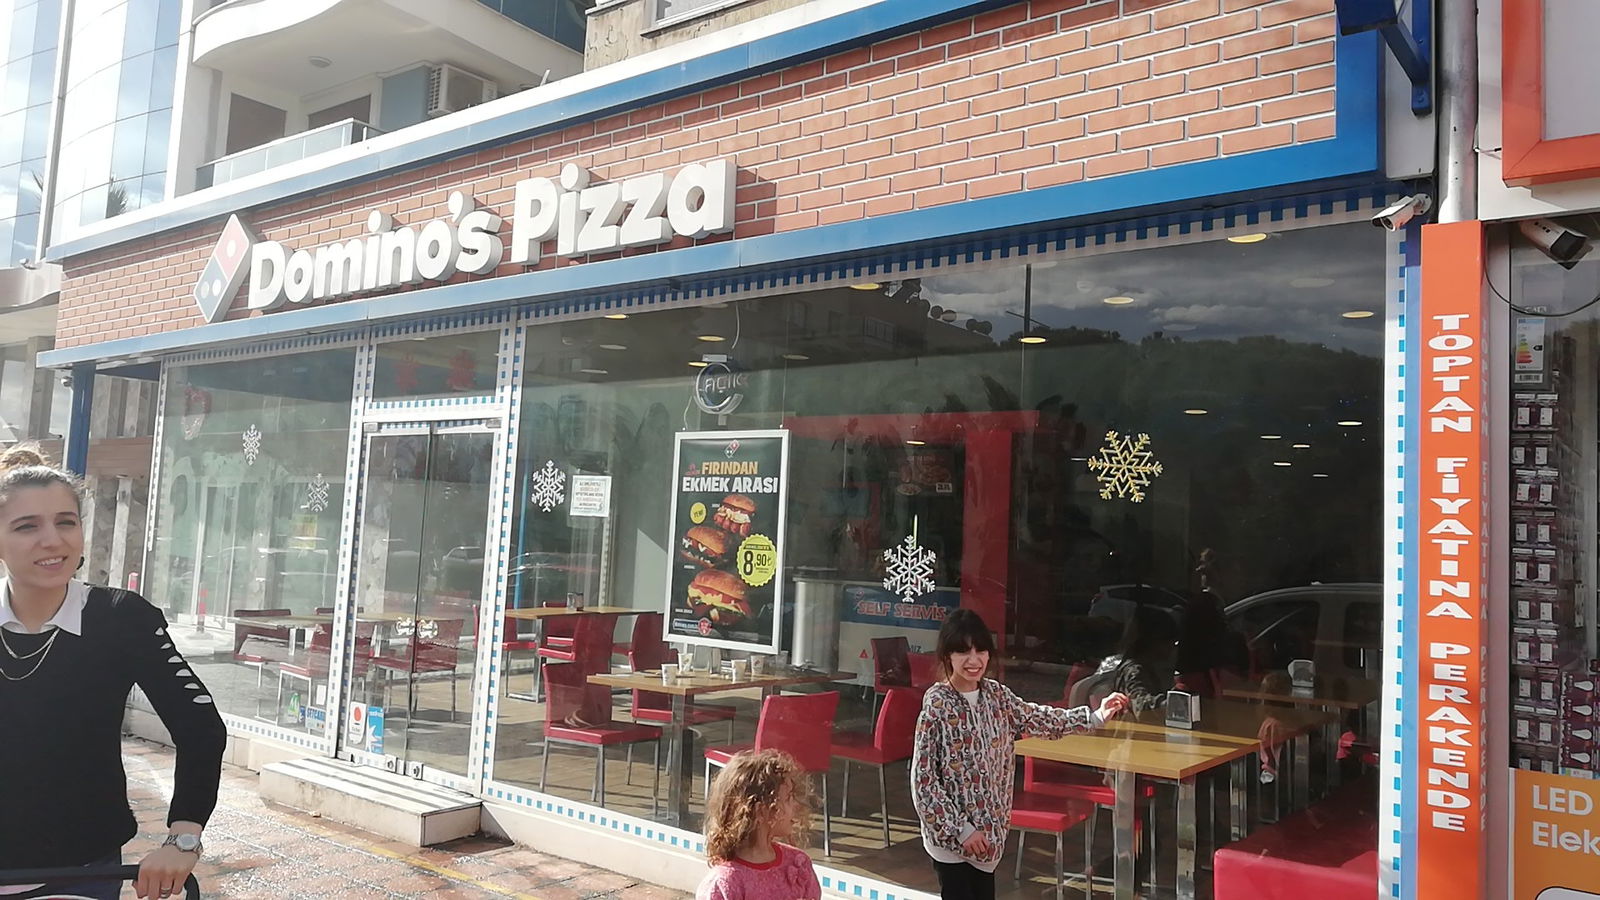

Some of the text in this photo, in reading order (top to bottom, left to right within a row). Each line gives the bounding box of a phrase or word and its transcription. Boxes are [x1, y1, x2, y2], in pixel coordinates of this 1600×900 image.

[247, 158, 737, 310] Domino's Pizza
[1428, 314, 1474, 432] TOPTAN
[701, 461, 758, 475] FIRINDAN
[682, 476, 778, 494] EKMEK ARASI
[857, 601, 947, 621] SELF SERVİS
[1426, 643, 1472, 831] PERAKENDE
[1533, 785, 1593, 816] LED
[1532, 821, 1600, 856] Elek
